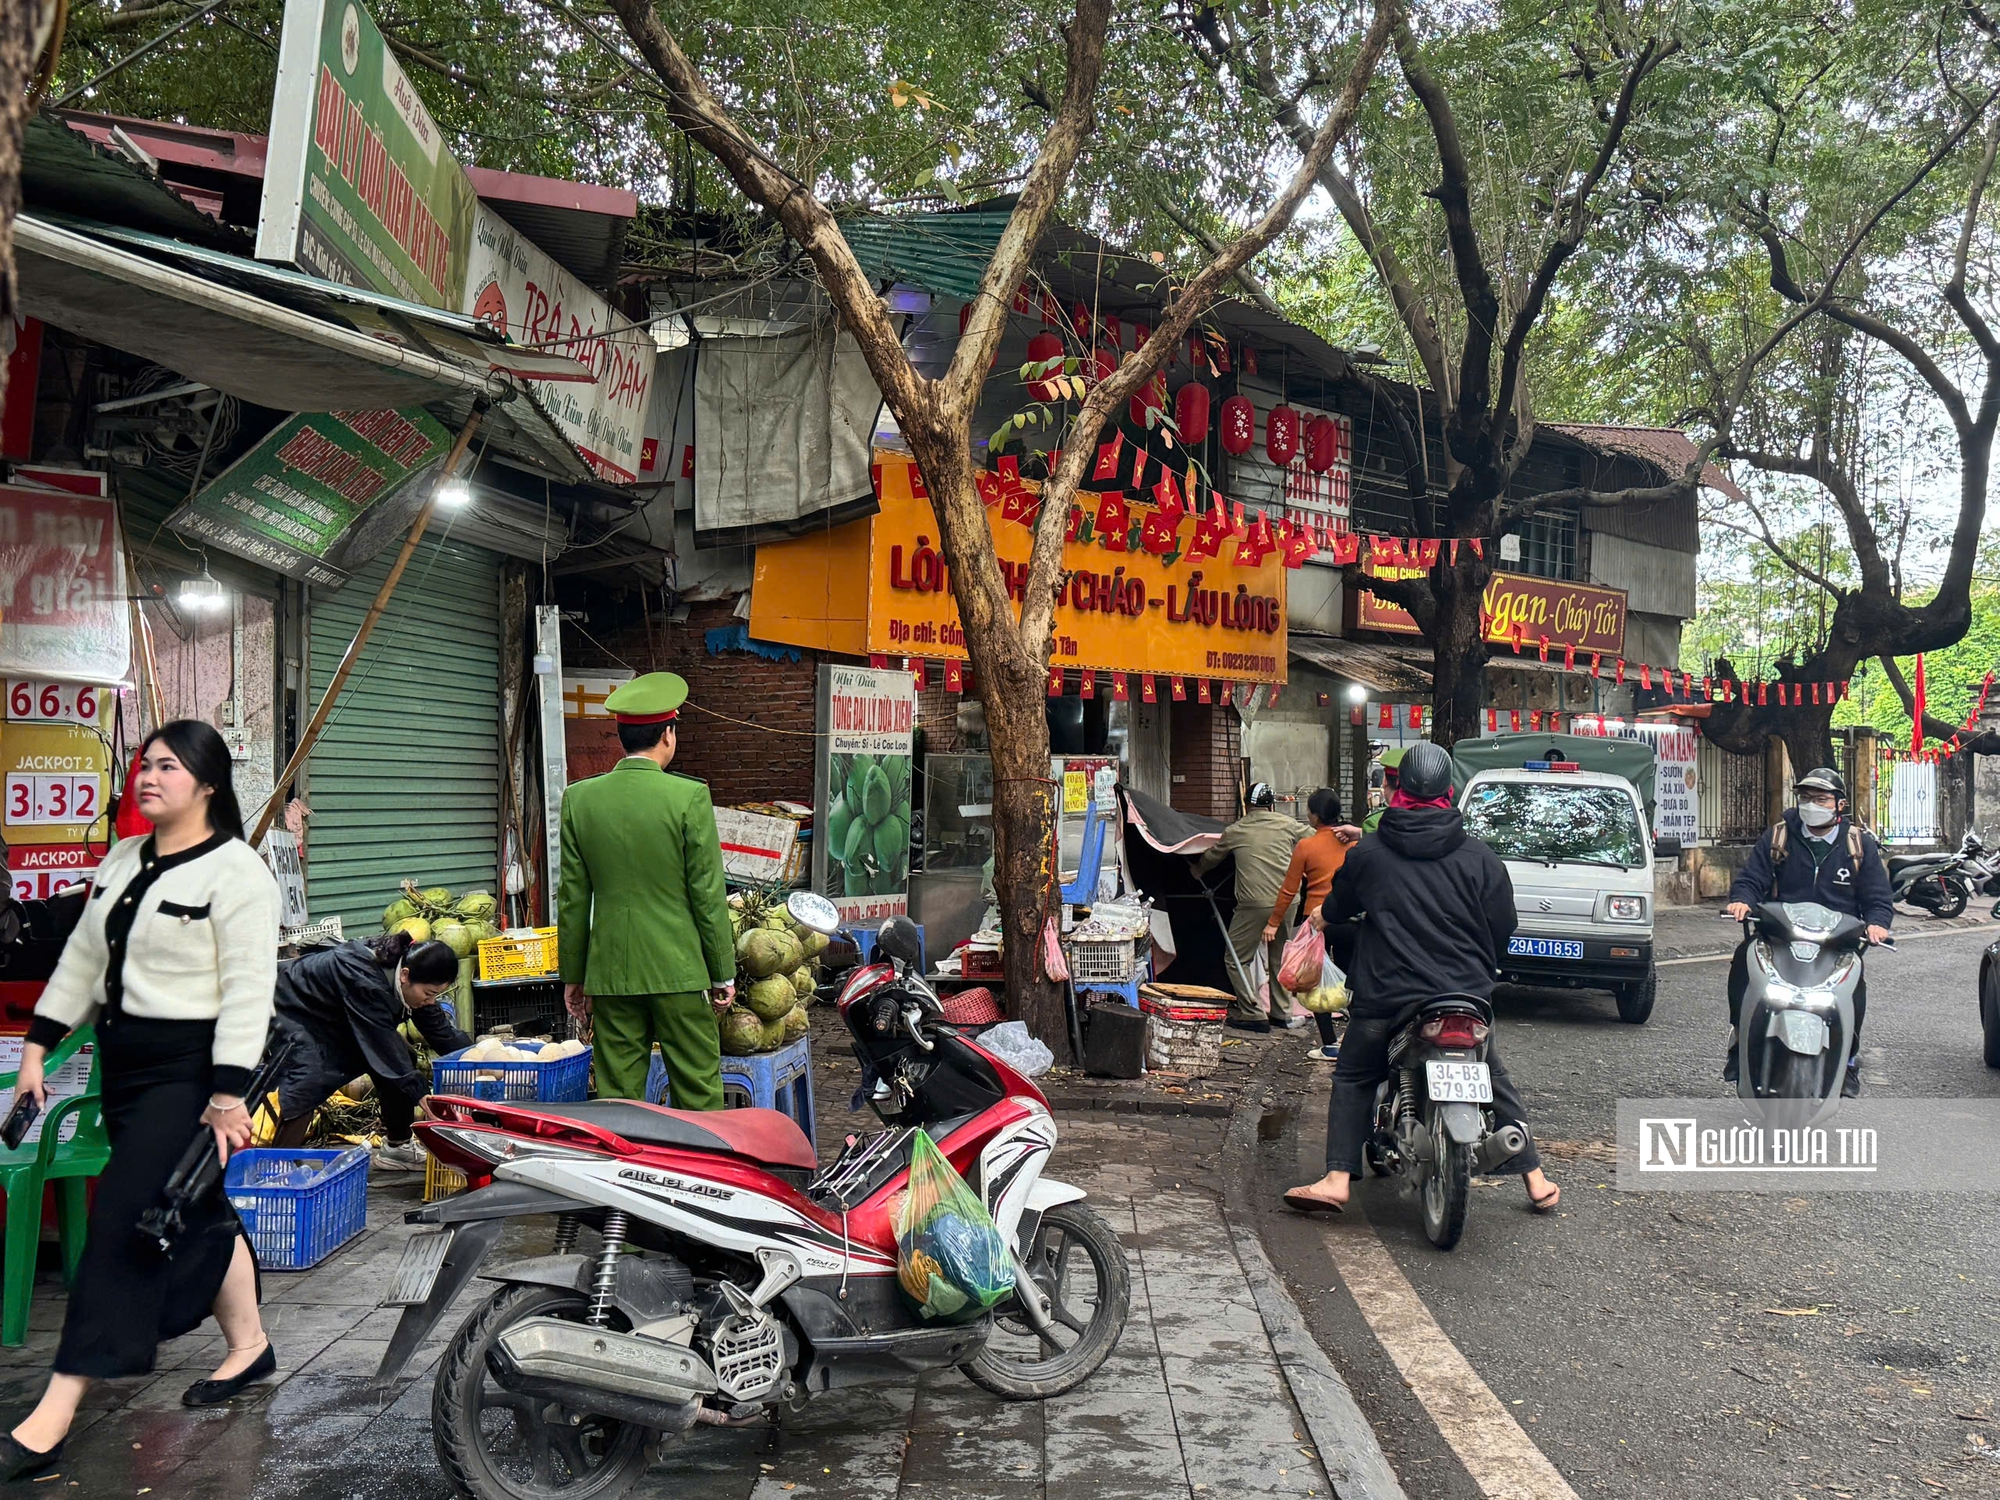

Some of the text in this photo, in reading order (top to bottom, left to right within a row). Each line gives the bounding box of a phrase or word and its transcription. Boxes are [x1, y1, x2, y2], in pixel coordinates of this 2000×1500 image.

[314, 61, 346, 176] ĐẠI
[340, 98, 364, 189] LÝ
[428, 221, 451, 298] TRE
[522, 281, 565, 354] TRÀ
[565, 308, 607, 380] ĐÀO
[890, 535, 954, 593] LÒN
[1373, 564, 1398, 578] MINH
[1071, 566, 1146, 617] CHÁO
[1167, 570, 1219, 627] LẨU
[1221, 583, 1281, 634] LÒNG
[1483, 577, 1548, 635] Ngan
[1554, 592, 1592, 645] Cháy
[1593, 598, 1620, 637] Tỏi
[889, 619, 910, 645] Địa
[1059, 636, 1078, 656] Tân
[1206, 650, 1221, 669] ĐT:
[832, 685, 912, 737] TỔNG ĐẠI LÝ DỪA XIÊM
[16, 756, 93, 770] JACKPOT 2
[10, 783, 95, 818] 3,32
[21, 851, 86, 867] JACKPOT
[1510, 939, 1581, 957] 29A-018.53
[1436, 1064, 1480, 1081] 34-B3
[1431, 1081, 1488, 1099] 579.30
[618, 1168, 736, 1201] AIR BLADE
